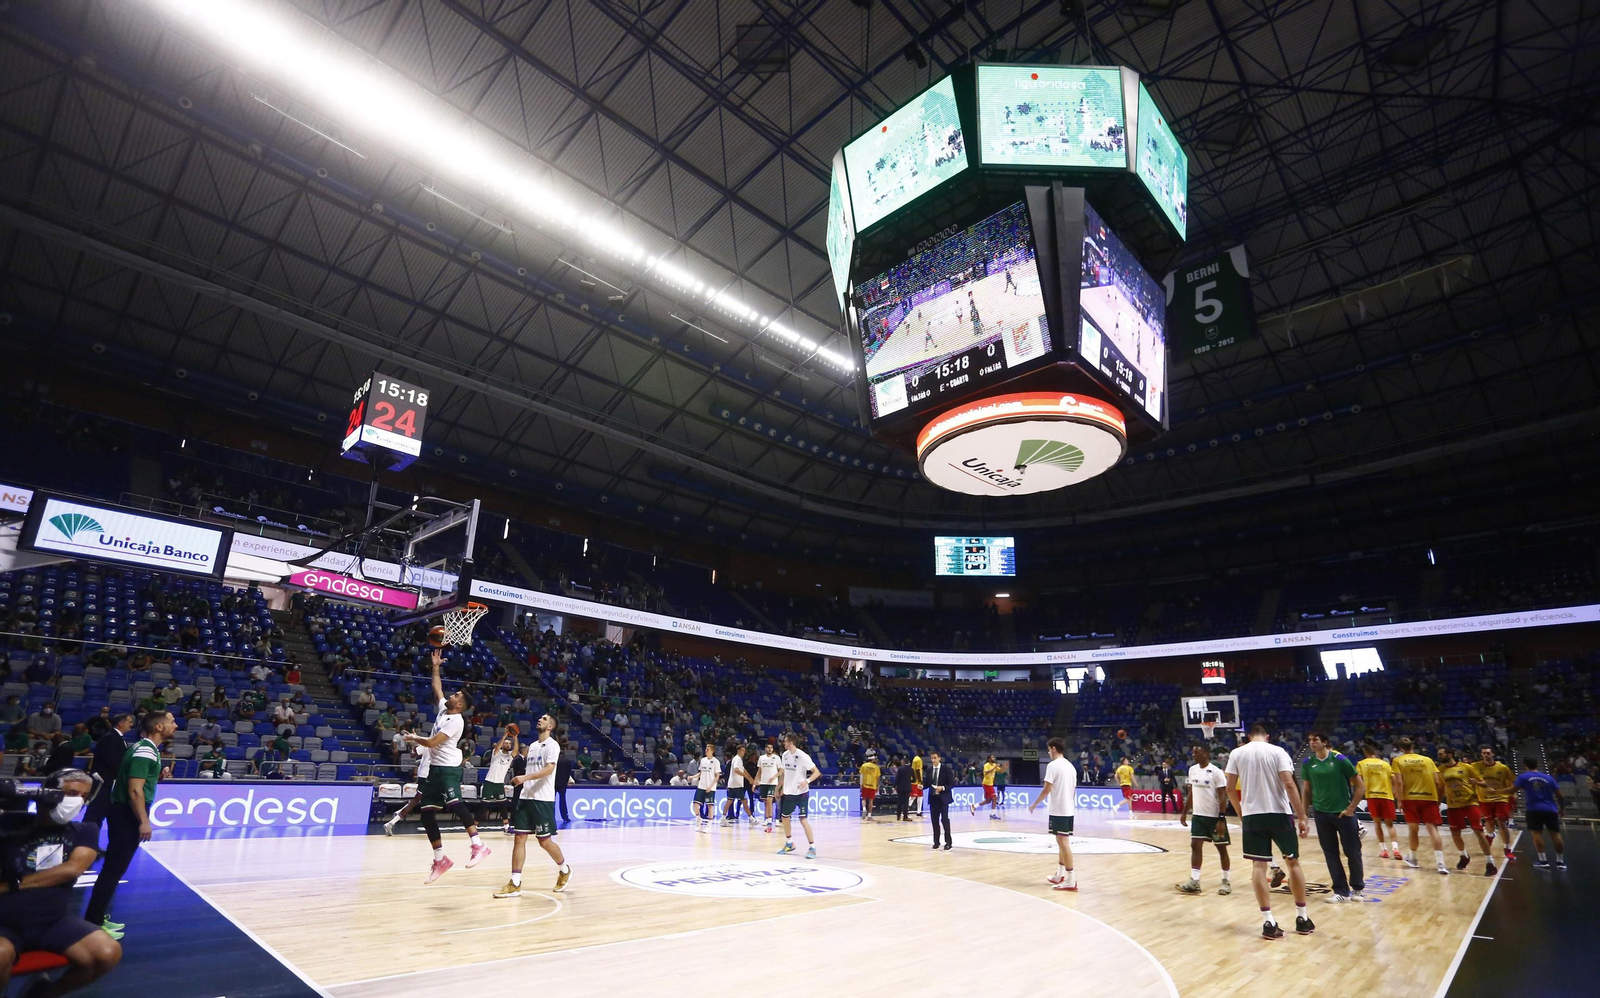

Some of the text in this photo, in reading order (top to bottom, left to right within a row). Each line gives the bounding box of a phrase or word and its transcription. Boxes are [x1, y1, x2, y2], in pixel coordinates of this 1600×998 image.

[917, 223, 958, 252] MONDO
[1186, 262, 1220, 283] BERNI
[1194, 280, 1223, 324] 5
[1193, 344, 1211, 355] 1999
[1217, 337, 1235, 348] 2012
[911, 343, 995, 388] 0 15:18 0
[1103, 347, 1109, 359] 0
[1115, 359, 1133, 383] 15:18
[1139, 379, 1144, 391] 0
[378, 380, 429, 407] 15:18
[346, 400, 364, 437] 24
[371, 401, 416, 438] 24
[961, 457, 1022, 489] Unicaja
[98, 534, 209, 562] Unicaja Banco
[243, 541, 300, 558] experiencia,
[304, 572, 384, 601] endesa
[478, 585, 523, 600] Construimos
[524, 594, 551, 606] hogares,
[564, 602, 600, 614] experiencia,
[601, 609, 629, 619] seguridad
[678, 622, 701, 632] ANSAN
[715, 628, 745, 639] Construimos
[1282, 635, 1312, 644] ANSAN
[1332, 630, 1378, 639] Construimos
[1379, 627, 1411, 636] hogares,
[1428, 621, 1477, 631] experiencia,
[1478, 616, 1521, 627] seguridad
[1529, 612, 1577, 622] eficiencia.
[1203, 668, 1218, 678] 24
[150, 789, 339, 827] endesa
[572, 791, 672, 819] endesa
[808, 791, 849, 813] desa
[653, 866, 819, 887] PEDRIZAS
